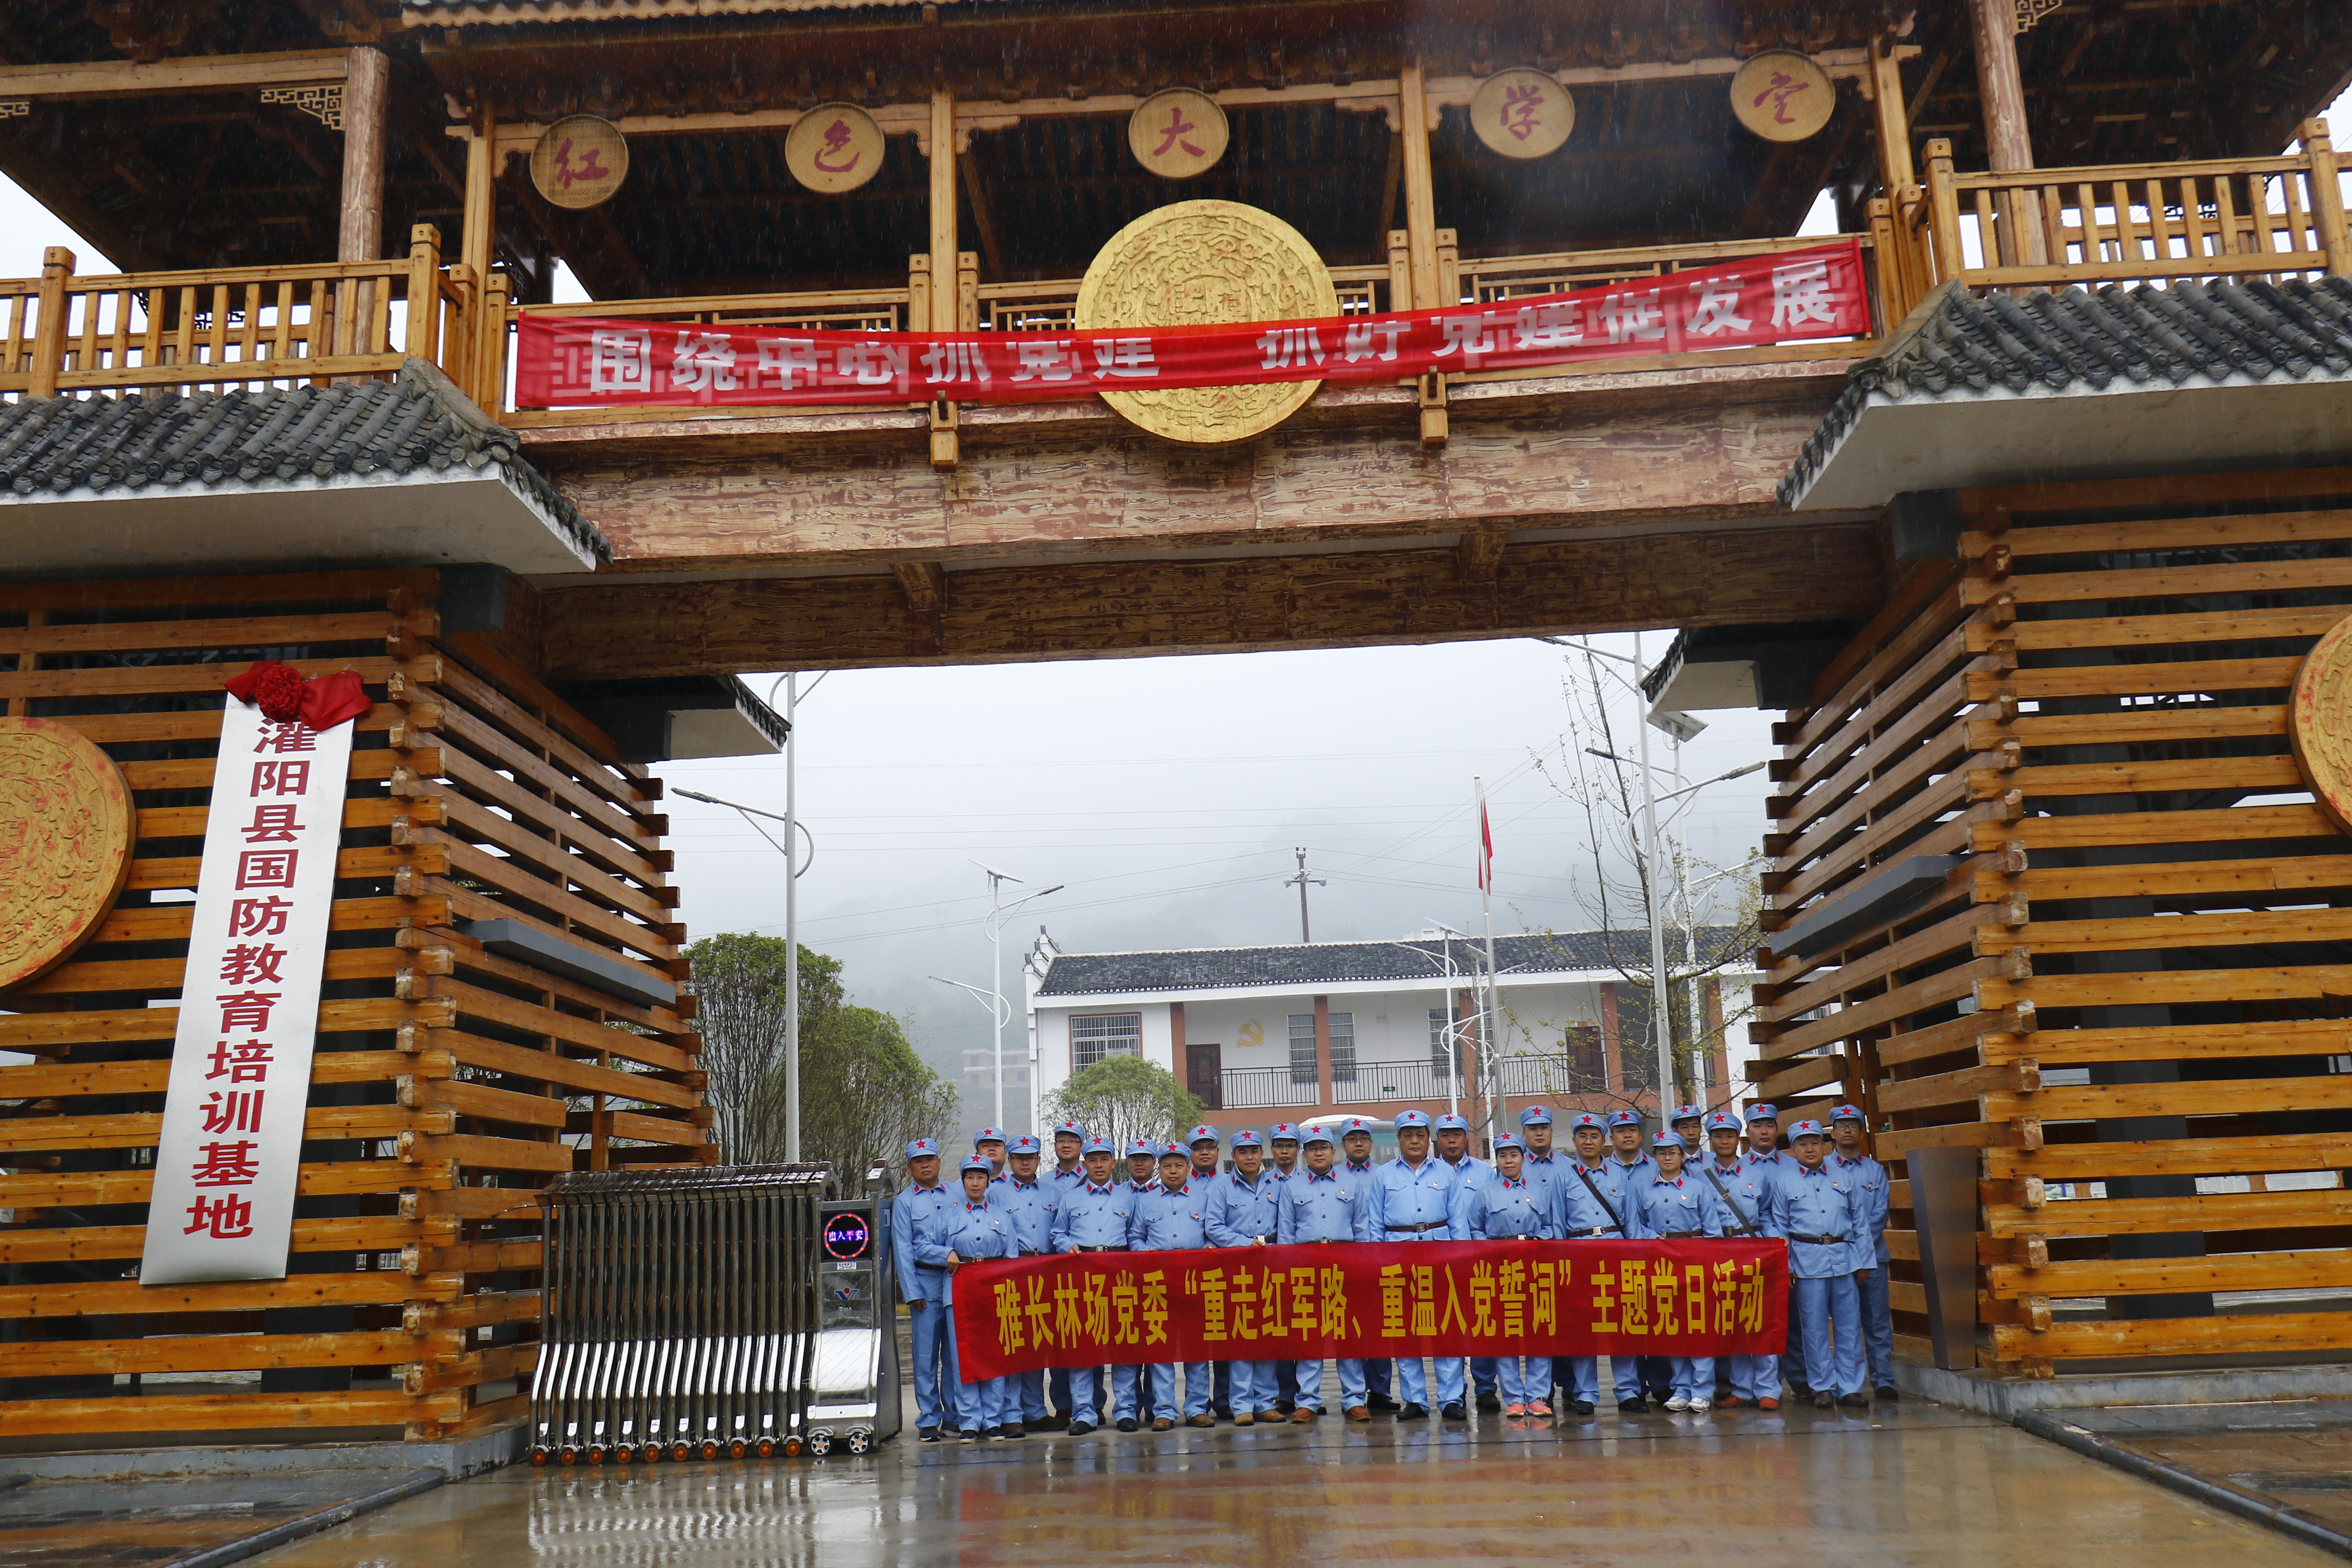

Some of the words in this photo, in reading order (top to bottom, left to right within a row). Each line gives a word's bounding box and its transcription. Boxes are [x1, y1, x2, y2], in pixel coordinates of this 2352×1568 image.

[183, 717, 318, 1239] 灌阳县国防教育培训基地
[829, 1229, 863, 1242] 出入平安
